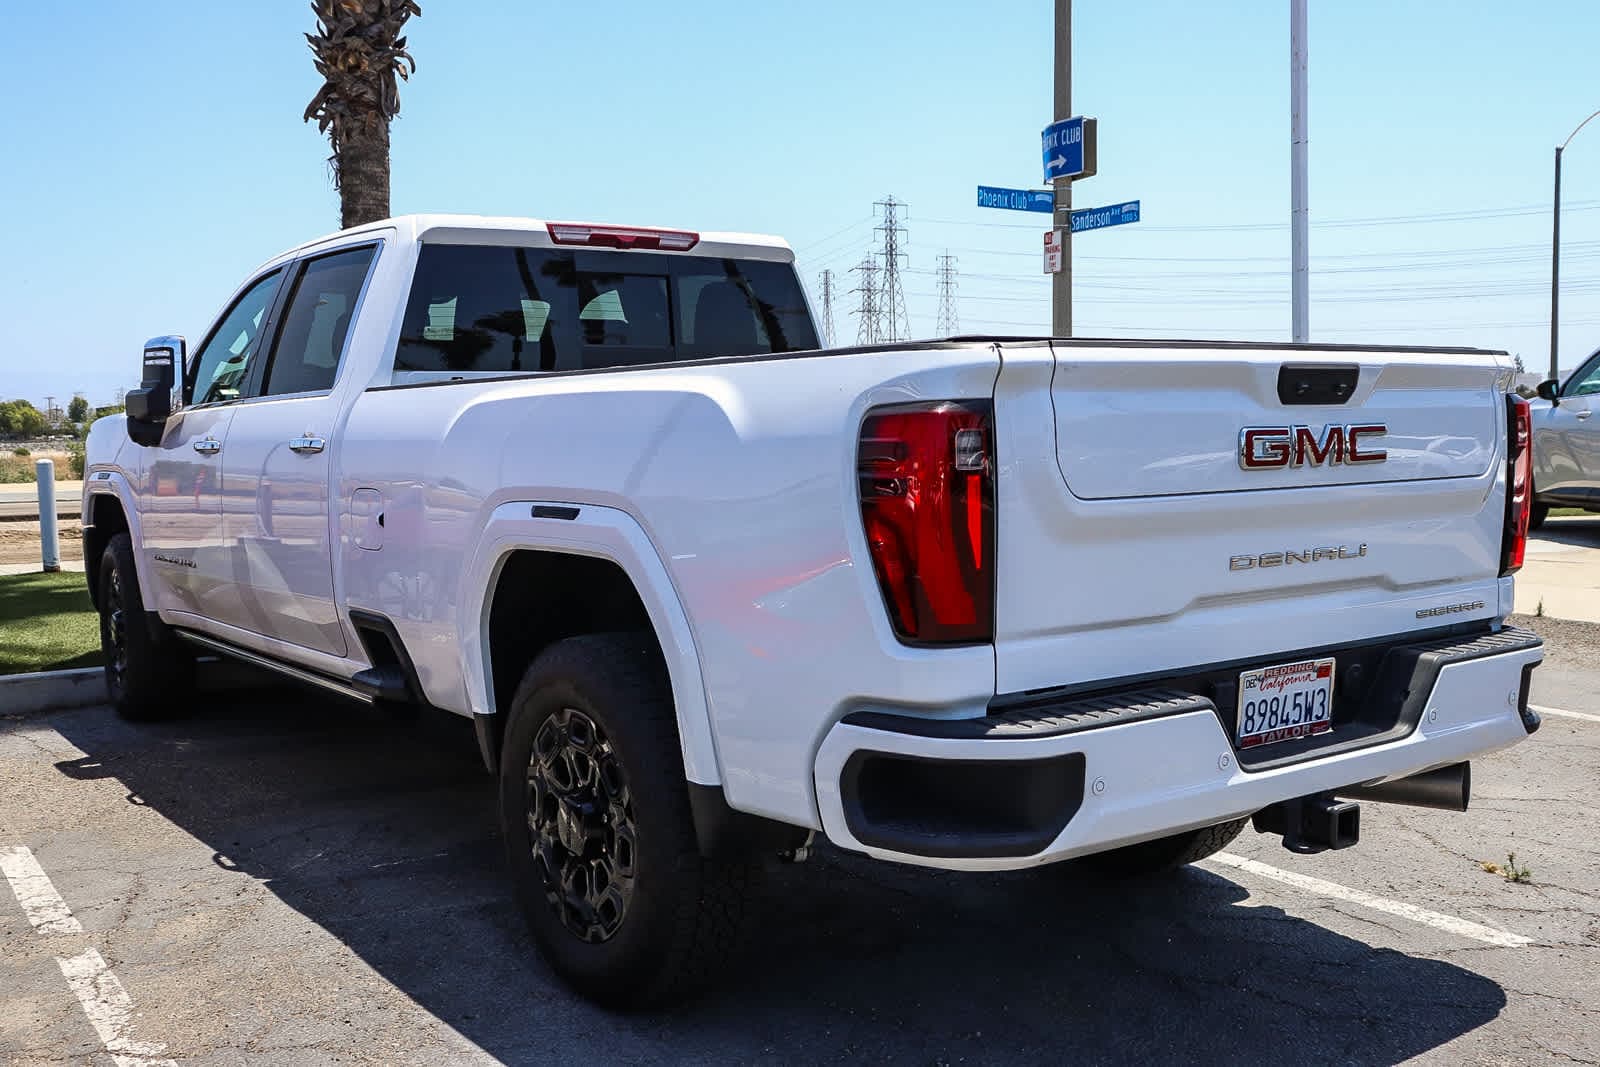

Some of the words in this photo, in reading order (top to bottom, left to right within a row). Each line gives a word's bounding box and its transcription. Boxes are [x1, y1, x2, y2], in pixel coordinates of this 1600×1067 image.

[1061, 126, 1081, 146] CLUB
[978, 189, 1009, 208] Phoenix
[1010, 191, 1028, 209] Club
[1071, 211, 1111, 231] Sanderson
[1238, 422, 1388, 471] GMC
[1229, 543, 1368, 572] DENALI
[1415, 600, 1485, 619] SIERRA
[1265, 662, 1314, 678] REDDING
[1259, 674, 1317, 693] California
[1244, 688, 1327, 735] 89845W3
[1261, 724, 1312, 744] TAYLOR
